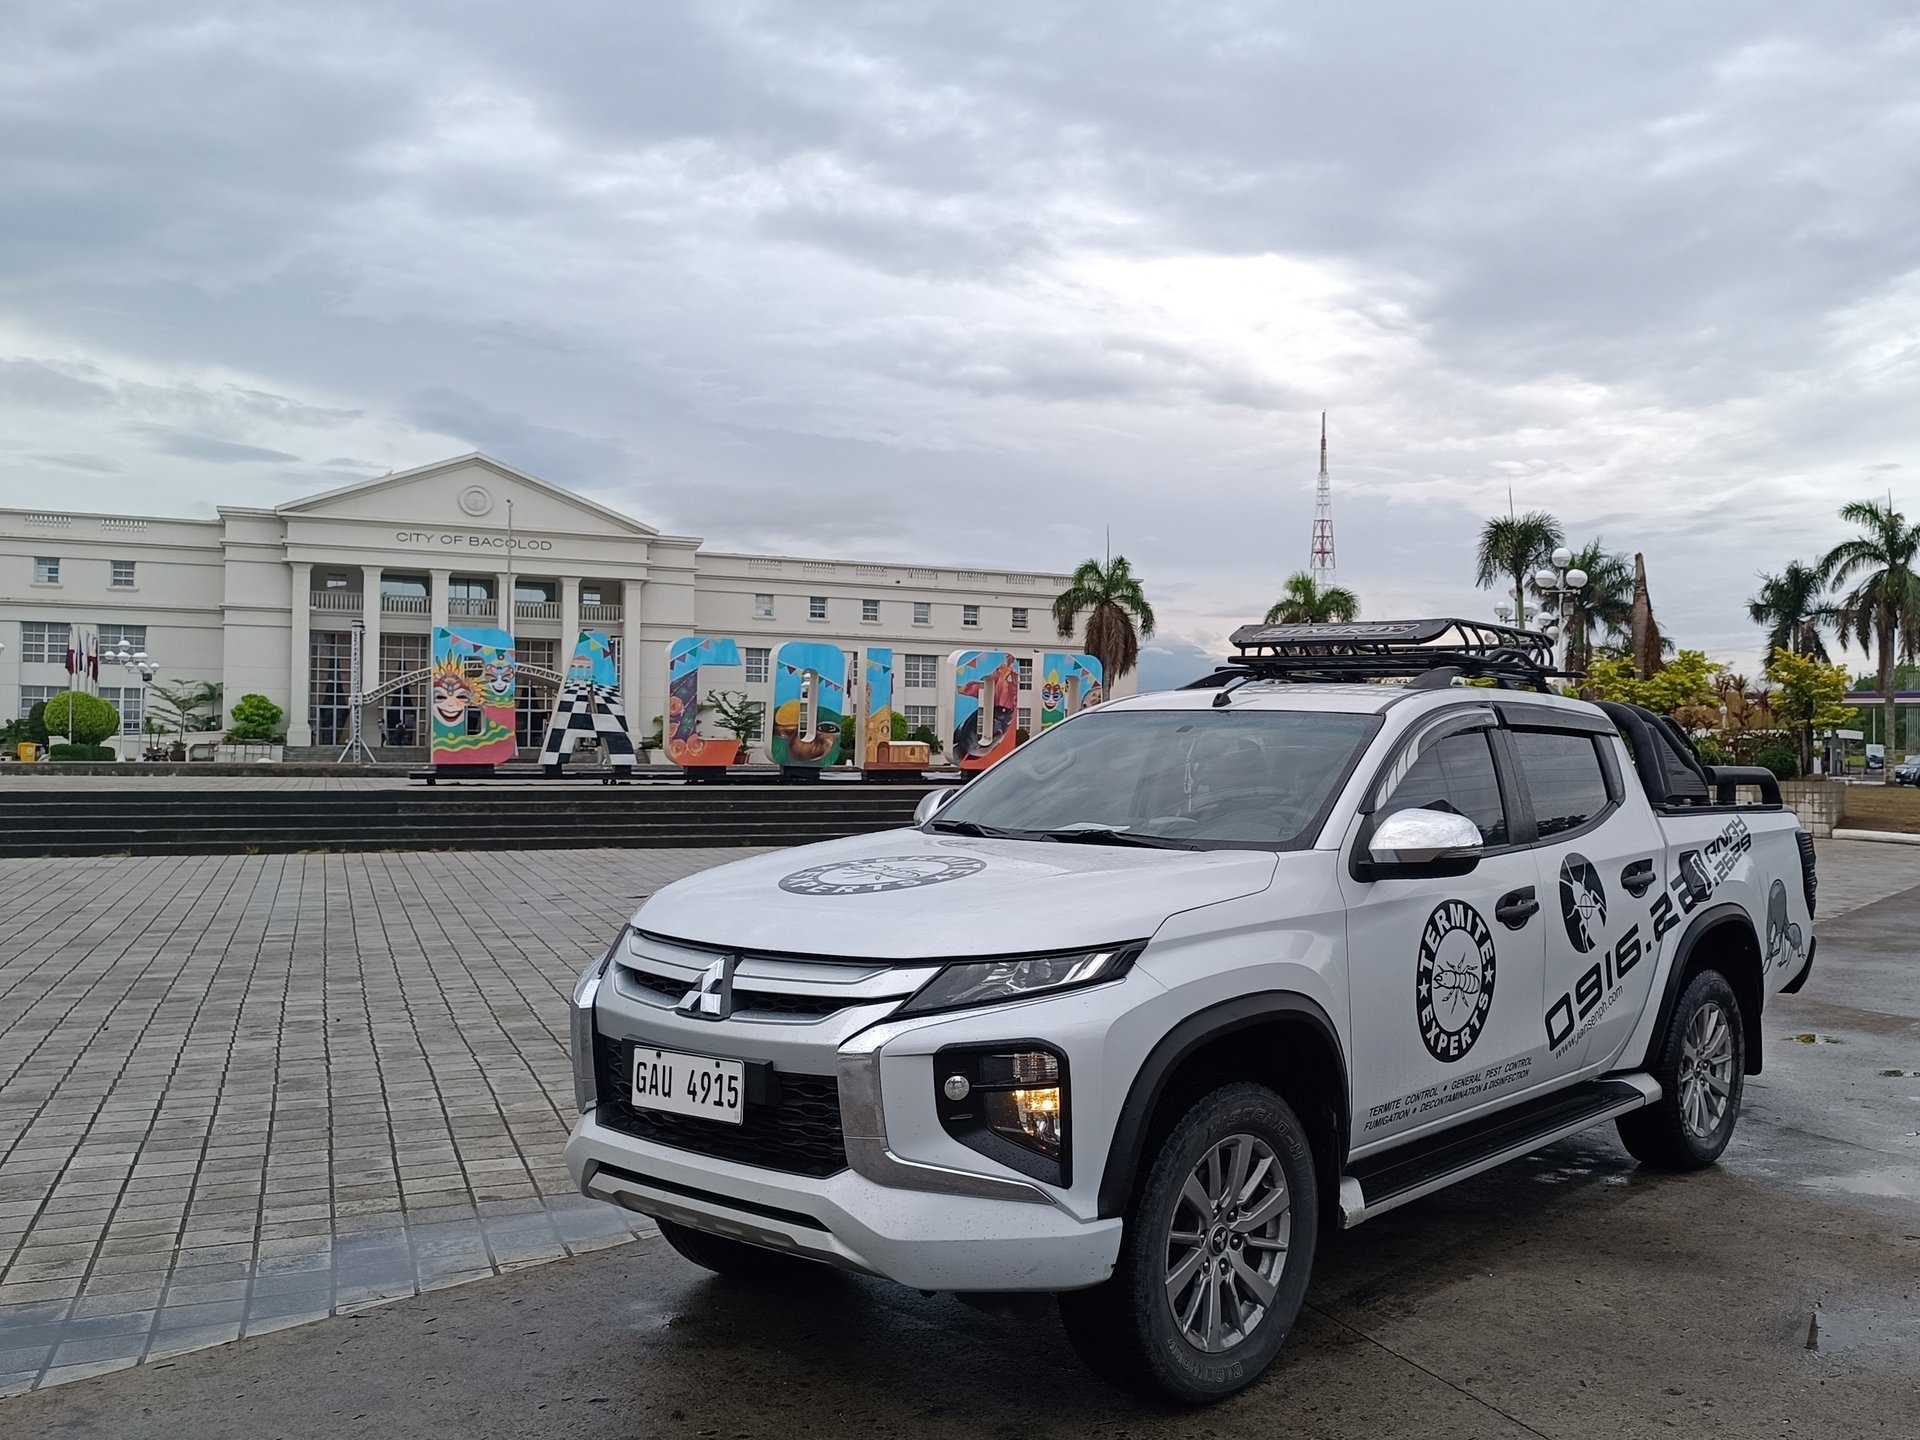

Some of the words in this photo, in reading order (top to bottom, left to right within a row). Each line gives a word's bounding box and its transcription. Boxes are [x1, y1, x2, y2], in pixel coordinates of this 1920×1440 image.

[396, 532, 434, 543] CITY
[440, 535, 463, 545] OF
[469, 536, 552, 551] BACOLOD
[788, 870, 922, 893] EXPERTS
[1419, 904, 1494, 973] TERMITE
[1421, 993, 1489, 1056] EXPERTS
[636, 1061, 672, 1098] GAU
[687, 1070, 739, 1108] 4915
[1364, 1107, 1411, 1132] FUMIGATION
[1420, 1087, 1482, 1112] DECONTAMINATION
[1489, 1069, 1530, 1090] DISINFECTION
[1369, 1100, 1401, 1117] TERMITE
[1405, 1087, 1439, 1106] CONTROL
[1451, 1072, 1481, 1090] GENERAL
[1485, 1066, 1503, 1079] PEST
[1504, 1056, 1533, 1072] CONTROL
